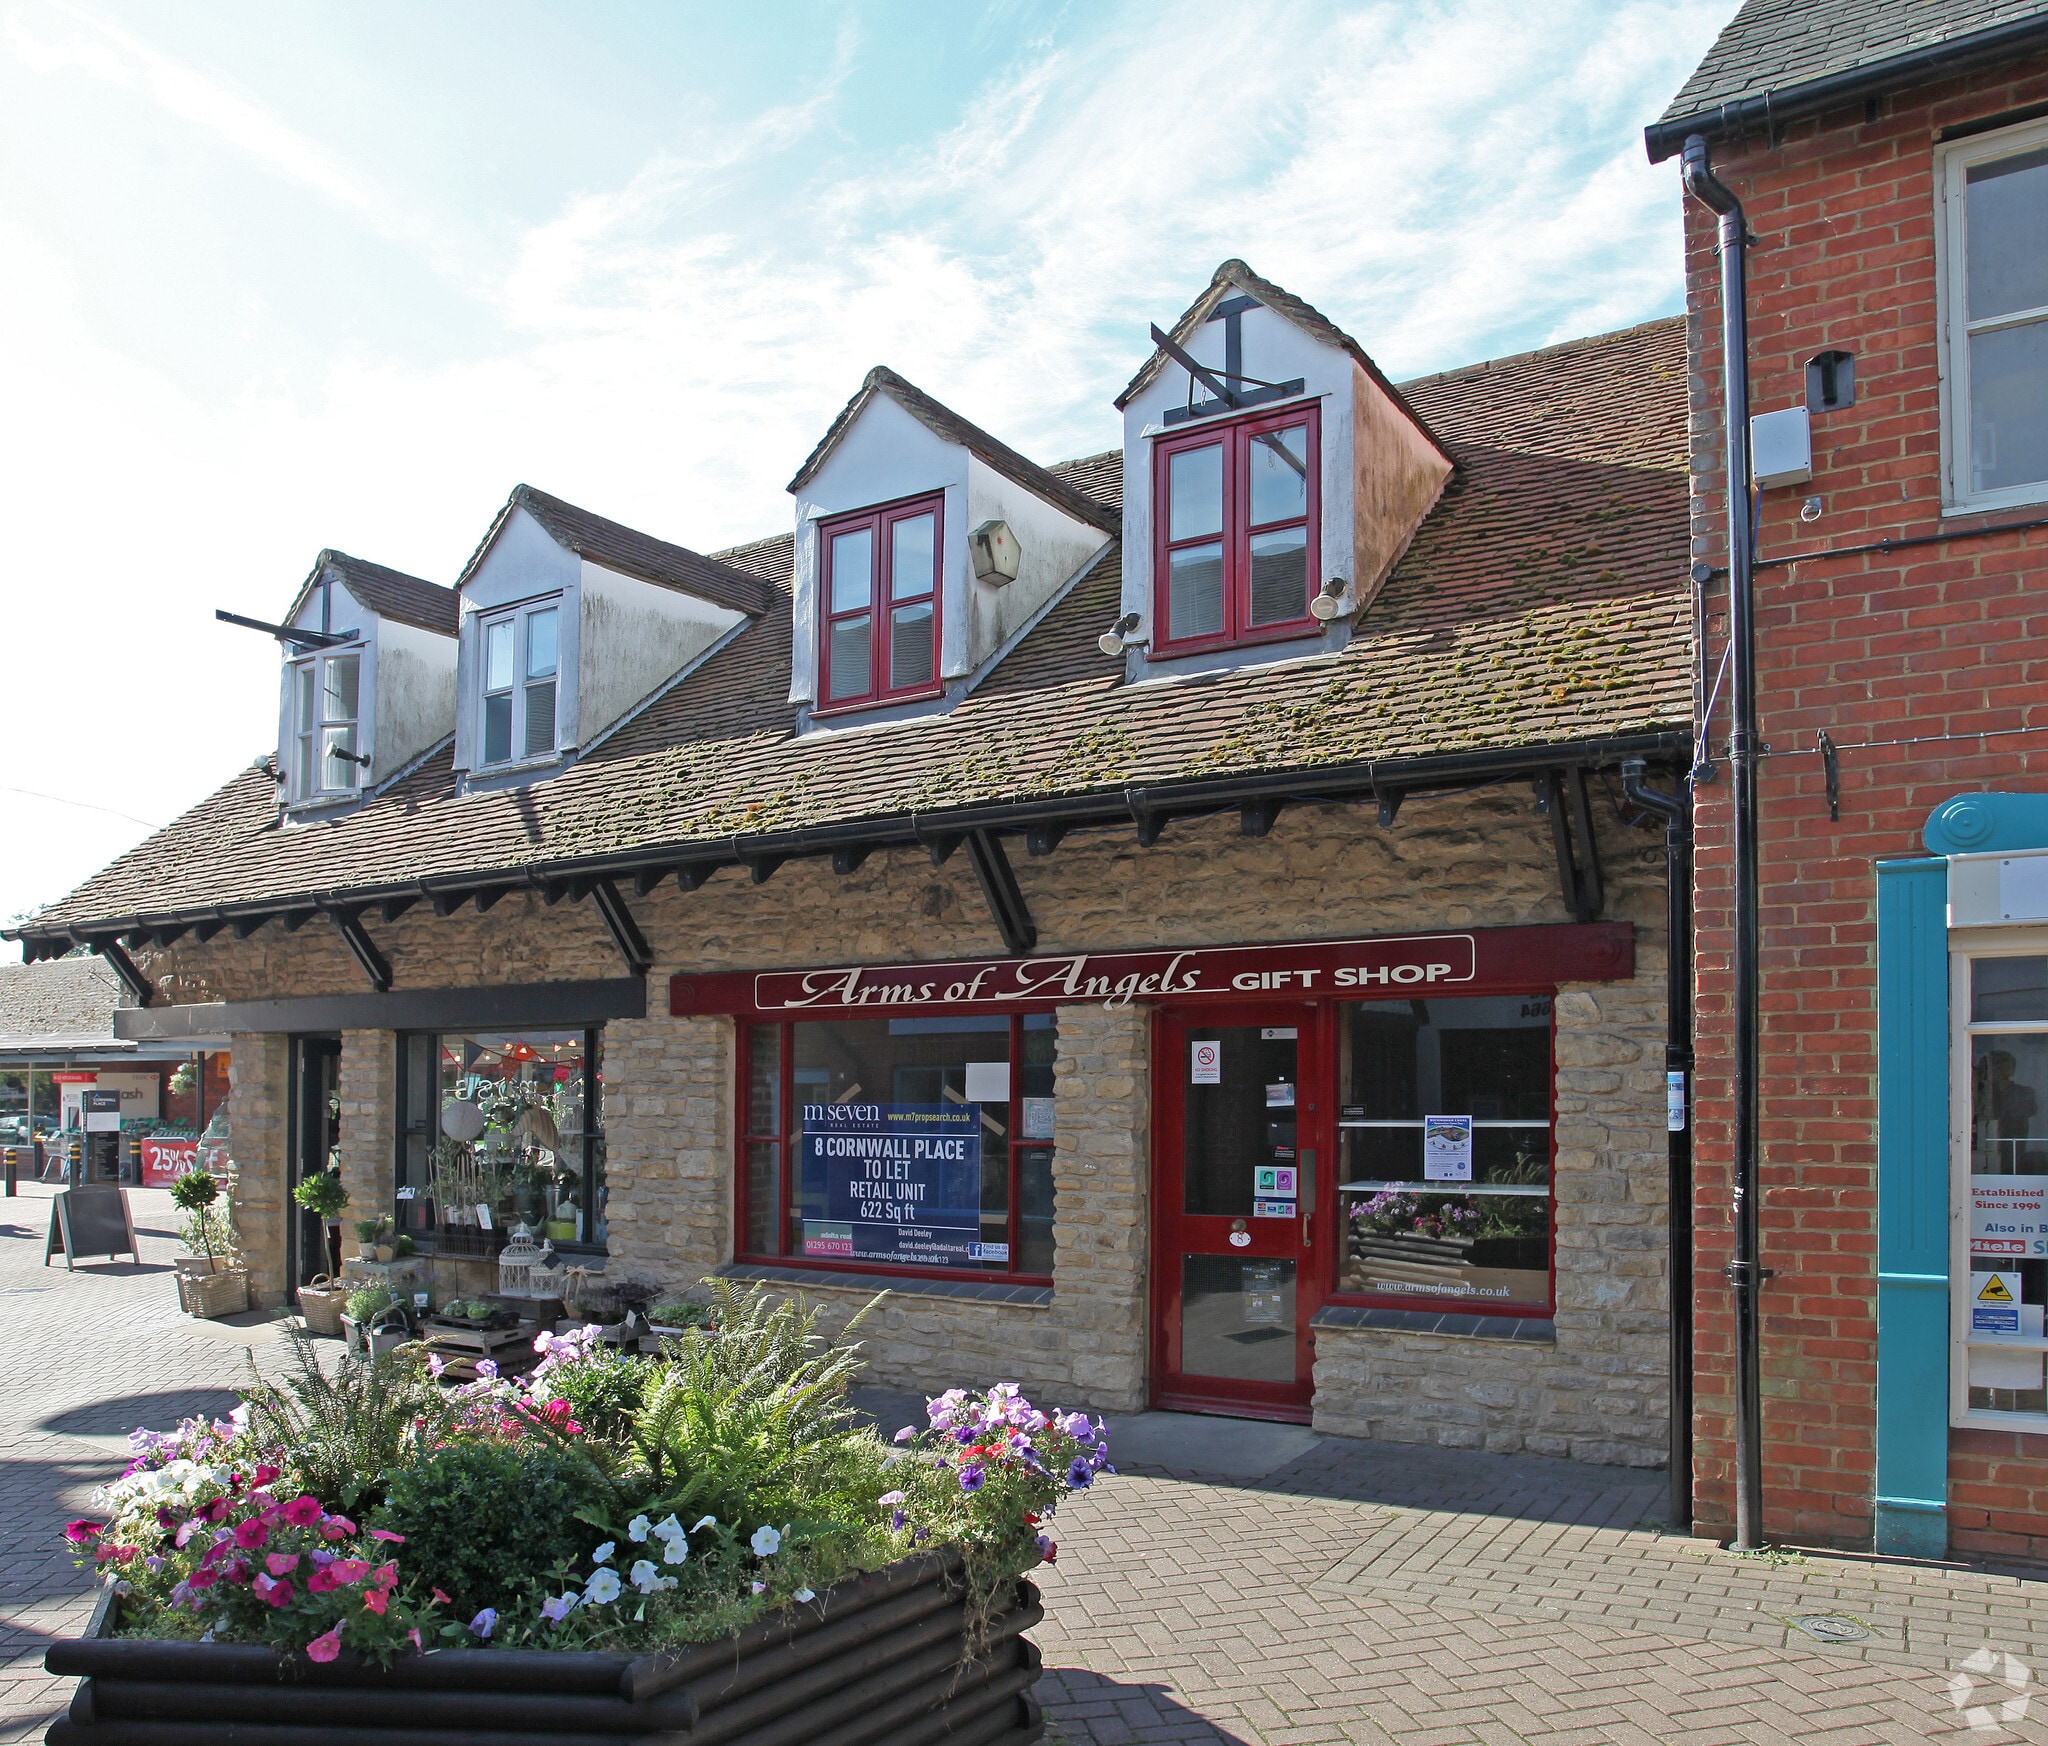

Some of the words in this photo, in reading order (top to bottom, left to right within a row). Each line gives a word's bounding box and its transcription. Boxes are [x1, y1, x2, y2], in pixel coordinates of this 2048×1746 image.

[784, 967, 937, 1008] Arms
[943, 966, 997, 1001] of
[996, 951, 1201, 1010] Angels
[1231, 969, 1321, 990] GIFT
[1334, 964, 1451, 986] SHOP
[121, 1087, 143, 1100] ash
[827, 1105, 880, 1121] seven
[887, 1112, 971, 1123] www.m7propsearch.co.uk
[815, 1138, 823, 1156] 8
[827, 1138, 911, 1159] CORNWALL
[915, 1139, 965, 1160] PLACE
[864, 1159, 881, 1179] TO
[886, 1160, 911, 1180] LET
[850, 1181, 892, 1199] RETAIL
[896, 1183, 925, 1200] UNIT
[1971, 1188, 2044, 1197] Established
[1975, 1200, 2008, 1209] Since
[2012, 1202, 2041, 1210] 1996
[860, 1201, 882, 1218] 622
[886, 1203, 901, 1223] Sq
[905, 1204, 915, 1220] ft
[914, 1229, 932, 1238] Deeley
[1985, 1223, 2016, 1232] Also
[2021, 1224, 2034, 1232] in
[806, 1241, 825, 1249] 01295
[827, 1242, 840, 1250] 670
[841, 1243, 852, 1251] 123
[1376, 1283, 1510, 1297] www.armsofangels.co.uk
